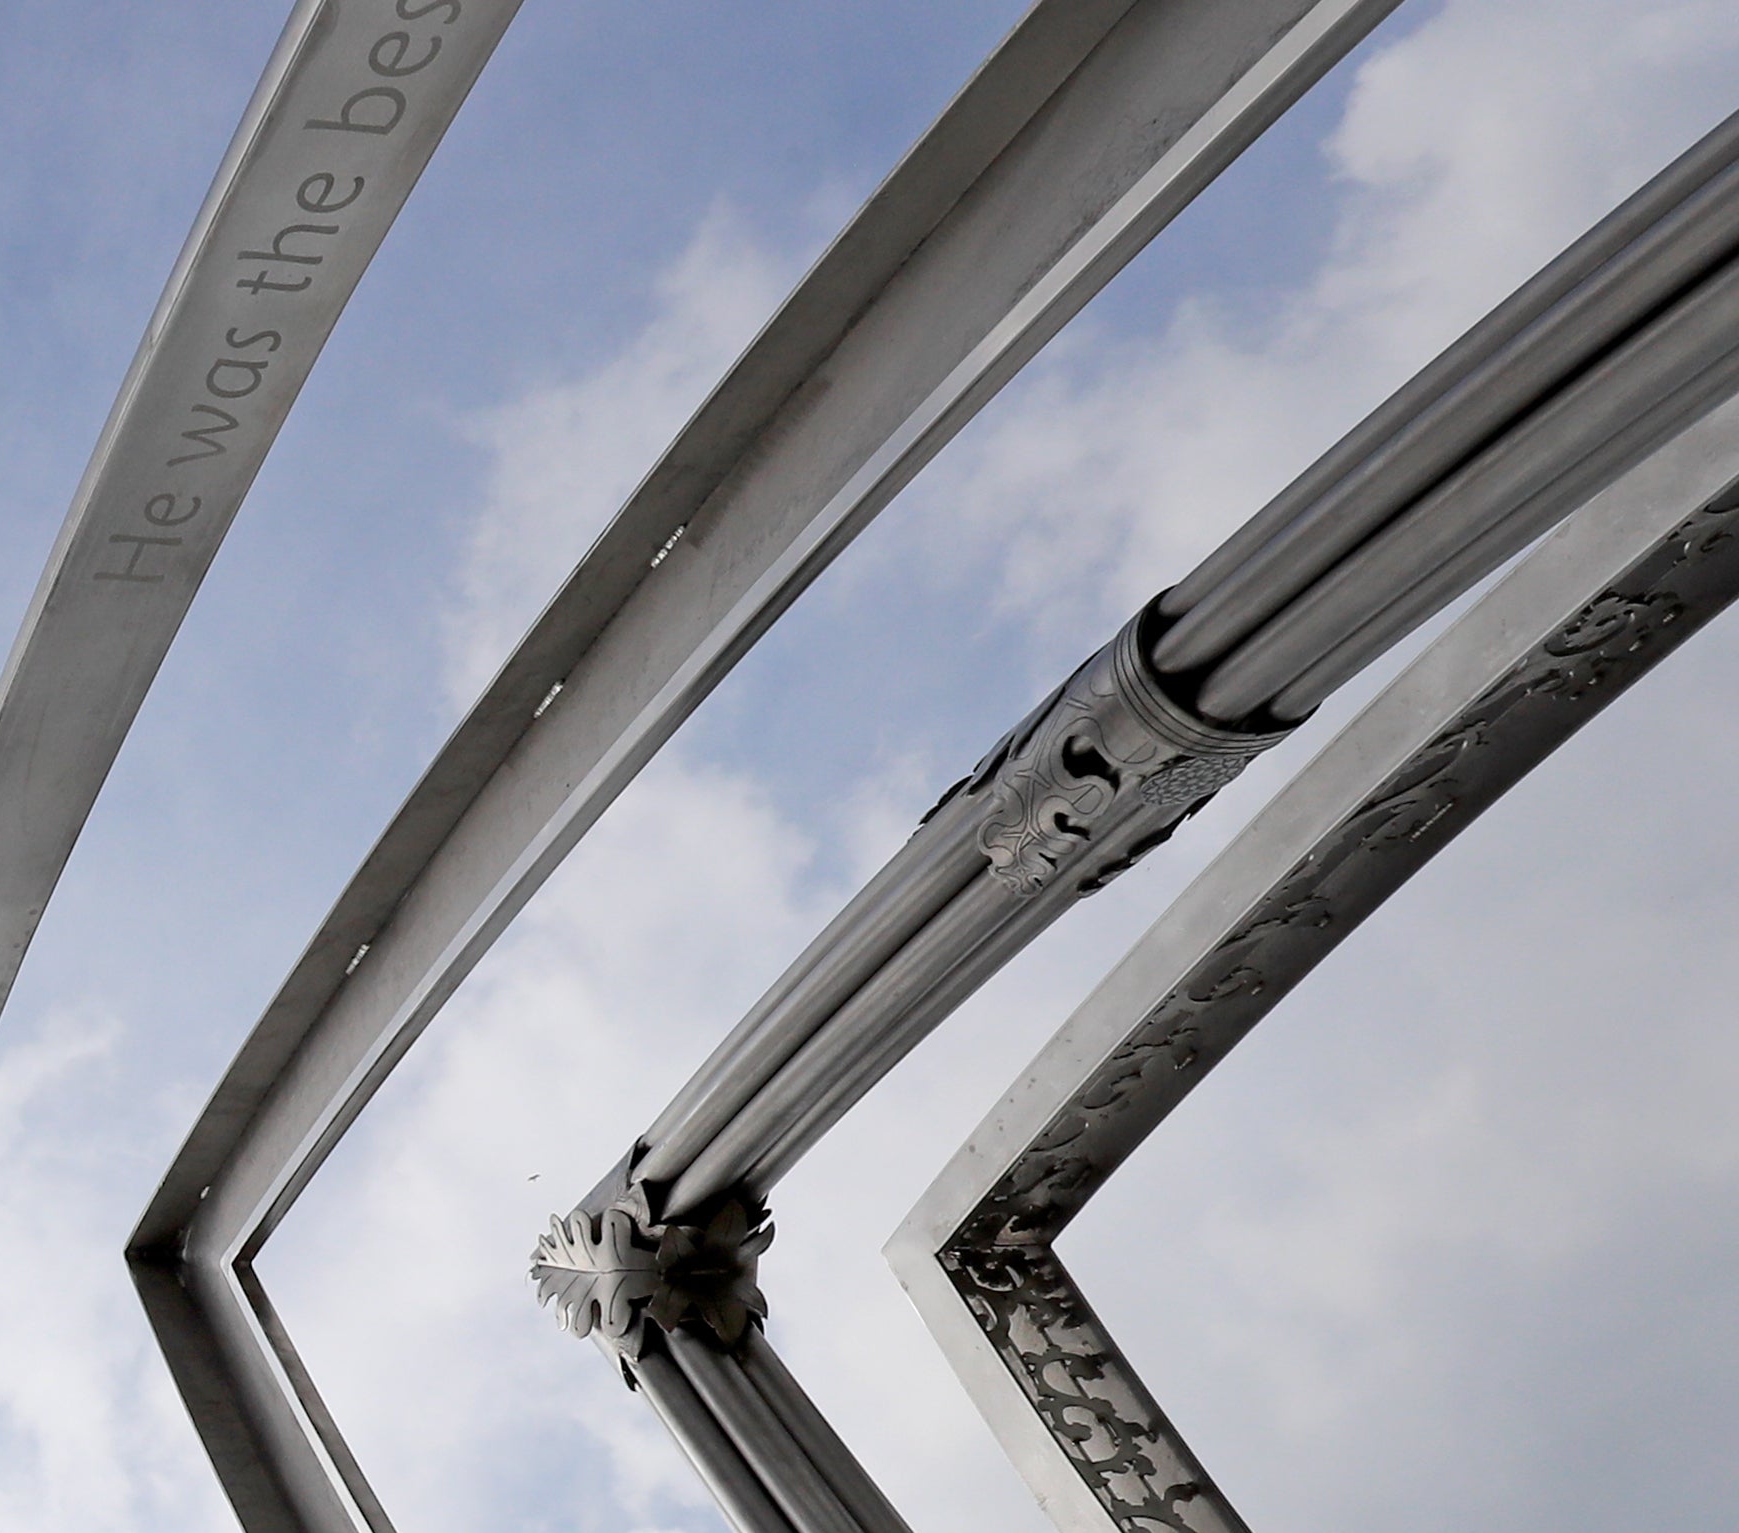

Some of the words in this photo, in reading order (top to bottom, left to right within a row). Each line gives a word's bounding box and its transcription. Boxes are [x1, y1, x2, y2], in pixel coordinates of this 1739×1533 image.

[93, 492, 201, 583] He
[166, 327, 282, 468] was
[236, 171, 365, 295] the
